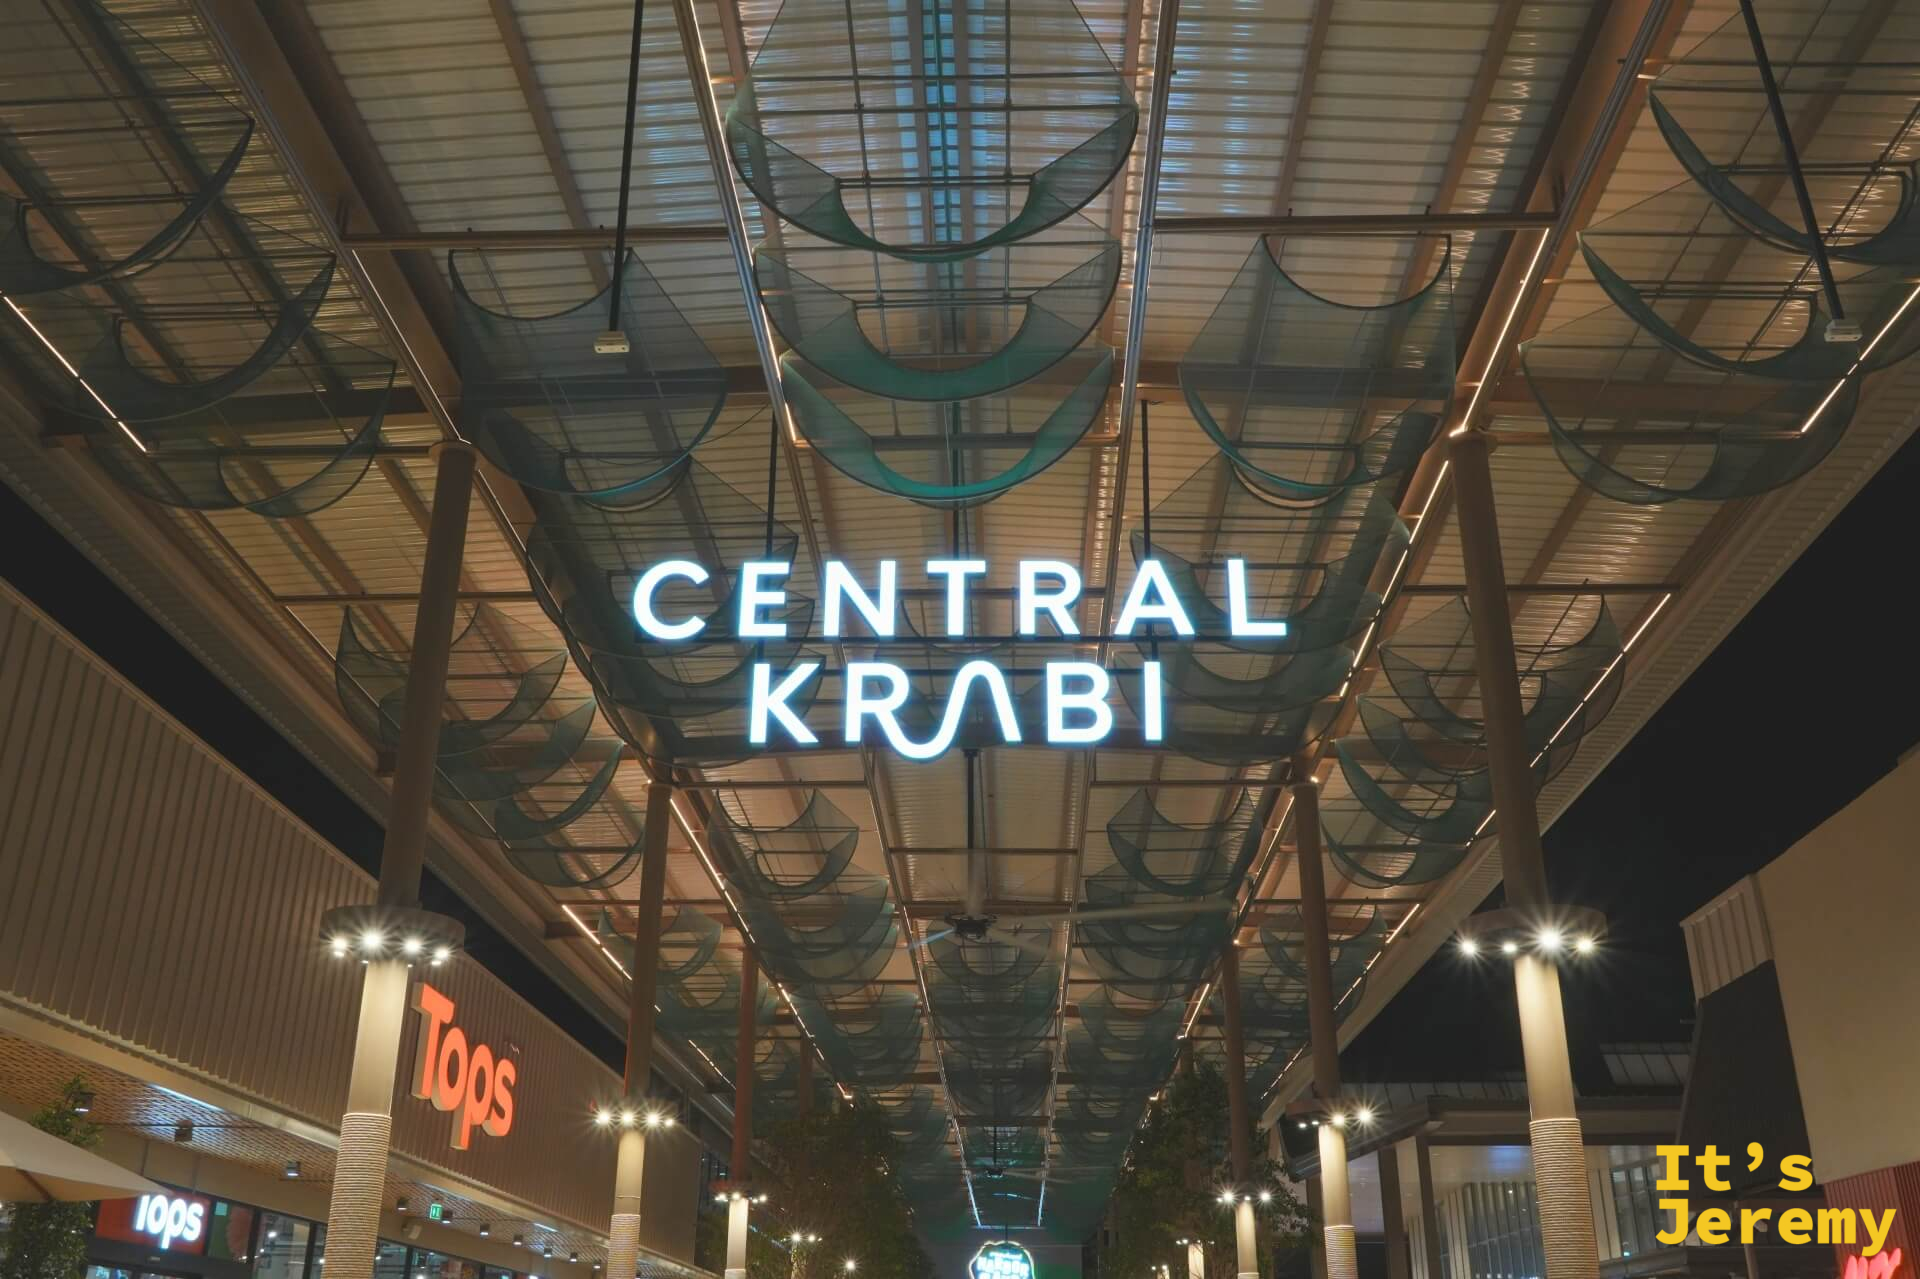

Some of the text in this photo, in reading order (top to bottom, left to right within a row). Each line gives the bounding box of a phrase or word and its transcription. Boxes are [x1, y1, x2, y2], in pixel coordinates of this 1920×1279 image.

[632, 559, 1287, 640] CENTRAL
[749, 659, 1163, 760] KRABI
[420, 983, 516, 1150] Tops
